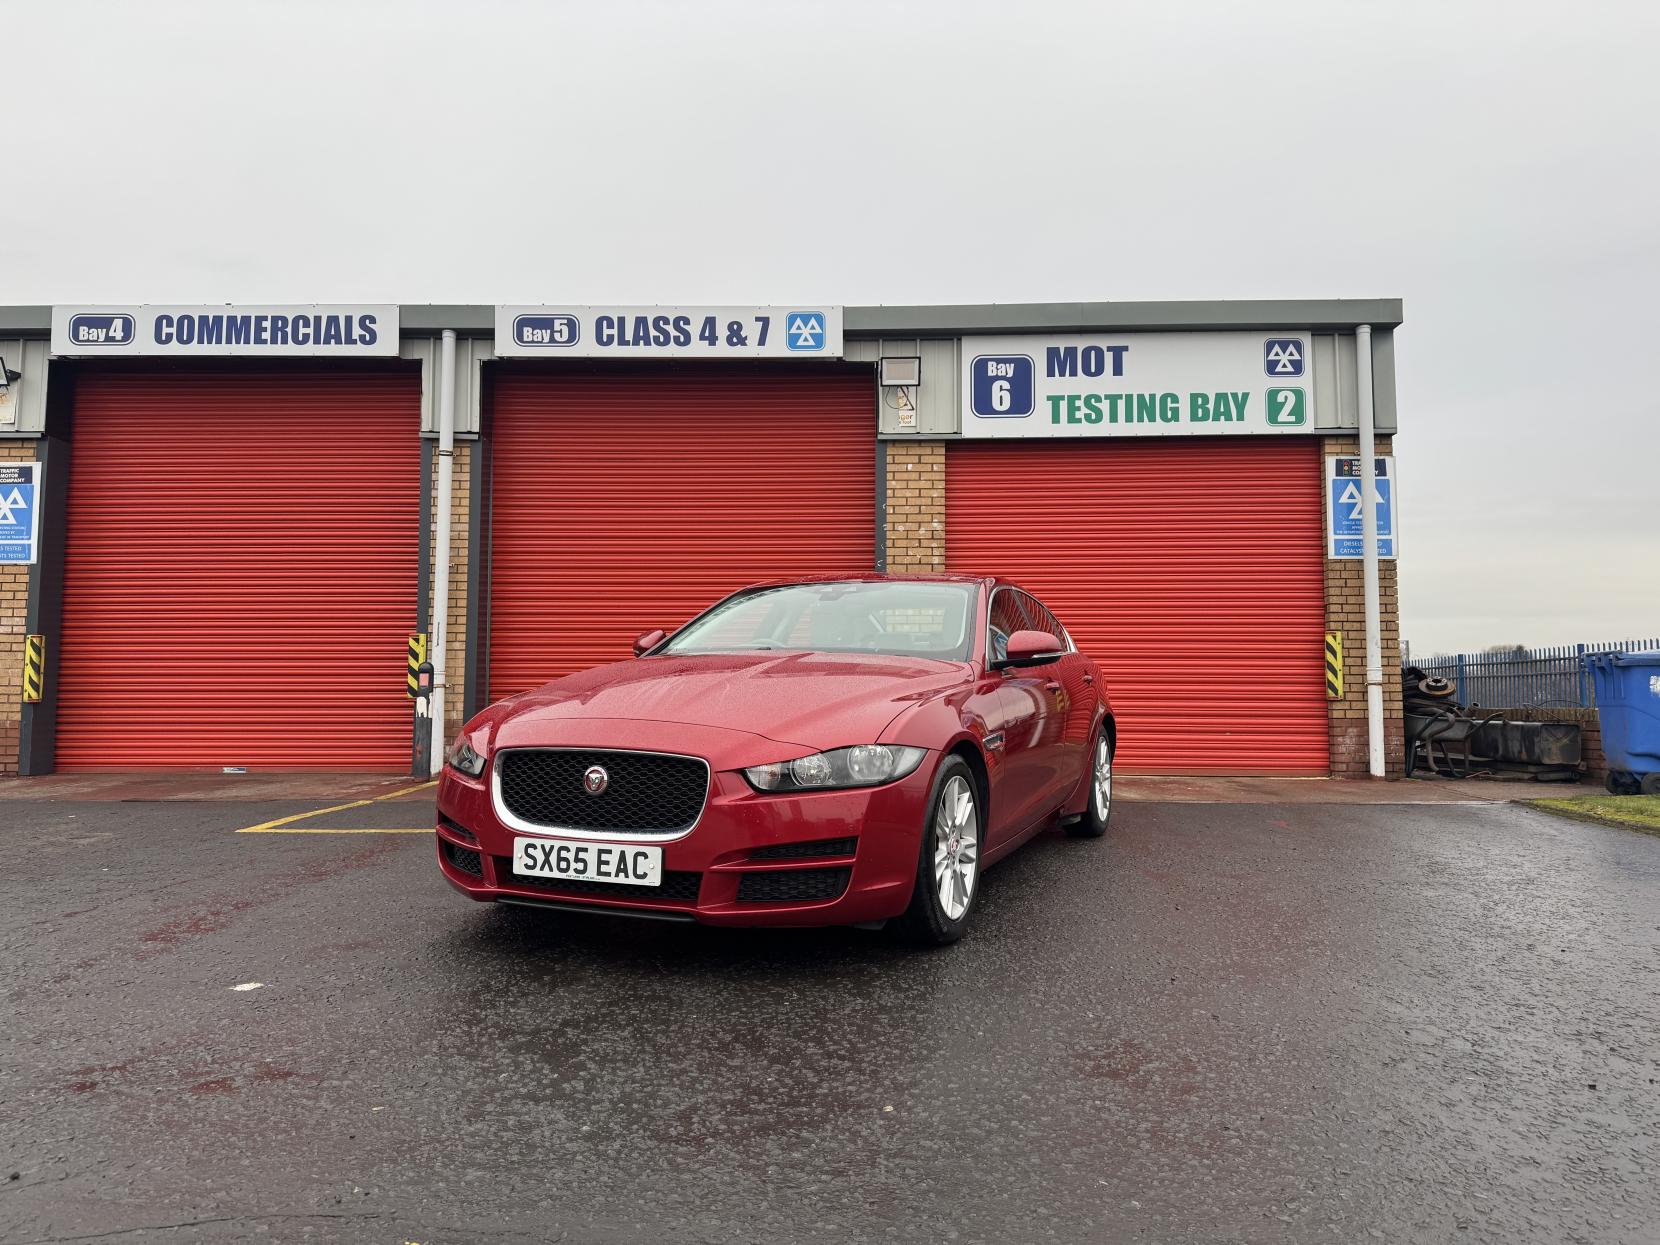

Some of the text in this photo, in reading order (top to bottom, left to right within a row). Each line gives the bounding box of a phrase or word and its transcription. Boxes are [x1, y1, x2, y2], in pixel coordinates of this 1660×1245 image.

[79, 318, 124, 342] Bay 4
[154, 314, 377, 346] COMMERCIALS
[523, 319, 569, 343] Bay 5
[595, 315, 771, 347] CLASS 4 & 7
[987, 361, 1015, 378] Bay
[1046, 345, 1129, 378] MOT
[991, 380, 1011, 411] 6
[1046, 391, 1250, 424] TESTING BAY
[1277, 390, 1297, 422] 2
[523, 842, 649, 880] SX65 EAC
